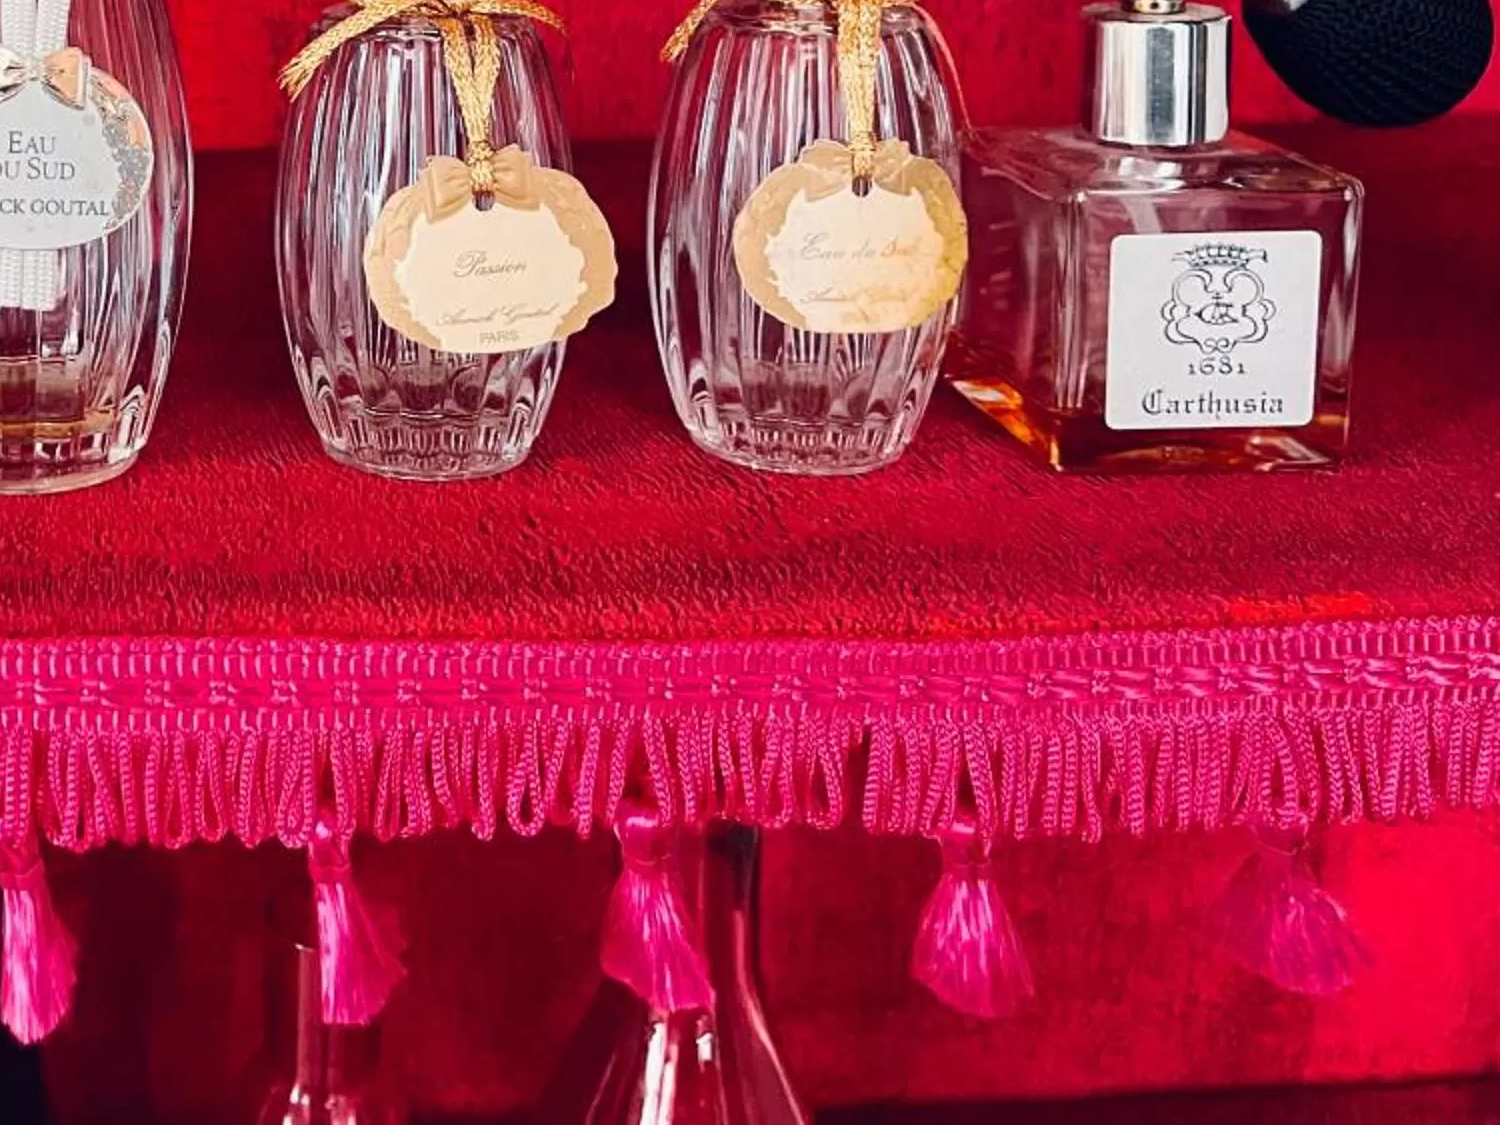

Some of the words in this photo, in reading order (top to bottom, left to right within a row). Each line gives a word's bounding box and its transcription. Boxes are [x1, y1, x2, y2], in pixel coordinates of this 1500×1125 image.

[30, 199, 110, 217] GOUTAL
[452, 250, 528, 278] Passion
[479, 330, 520, 344] PARIS
[1188, 356, 1247, 376] 1681
[1142, 388, 1284, 420] Carthusia
